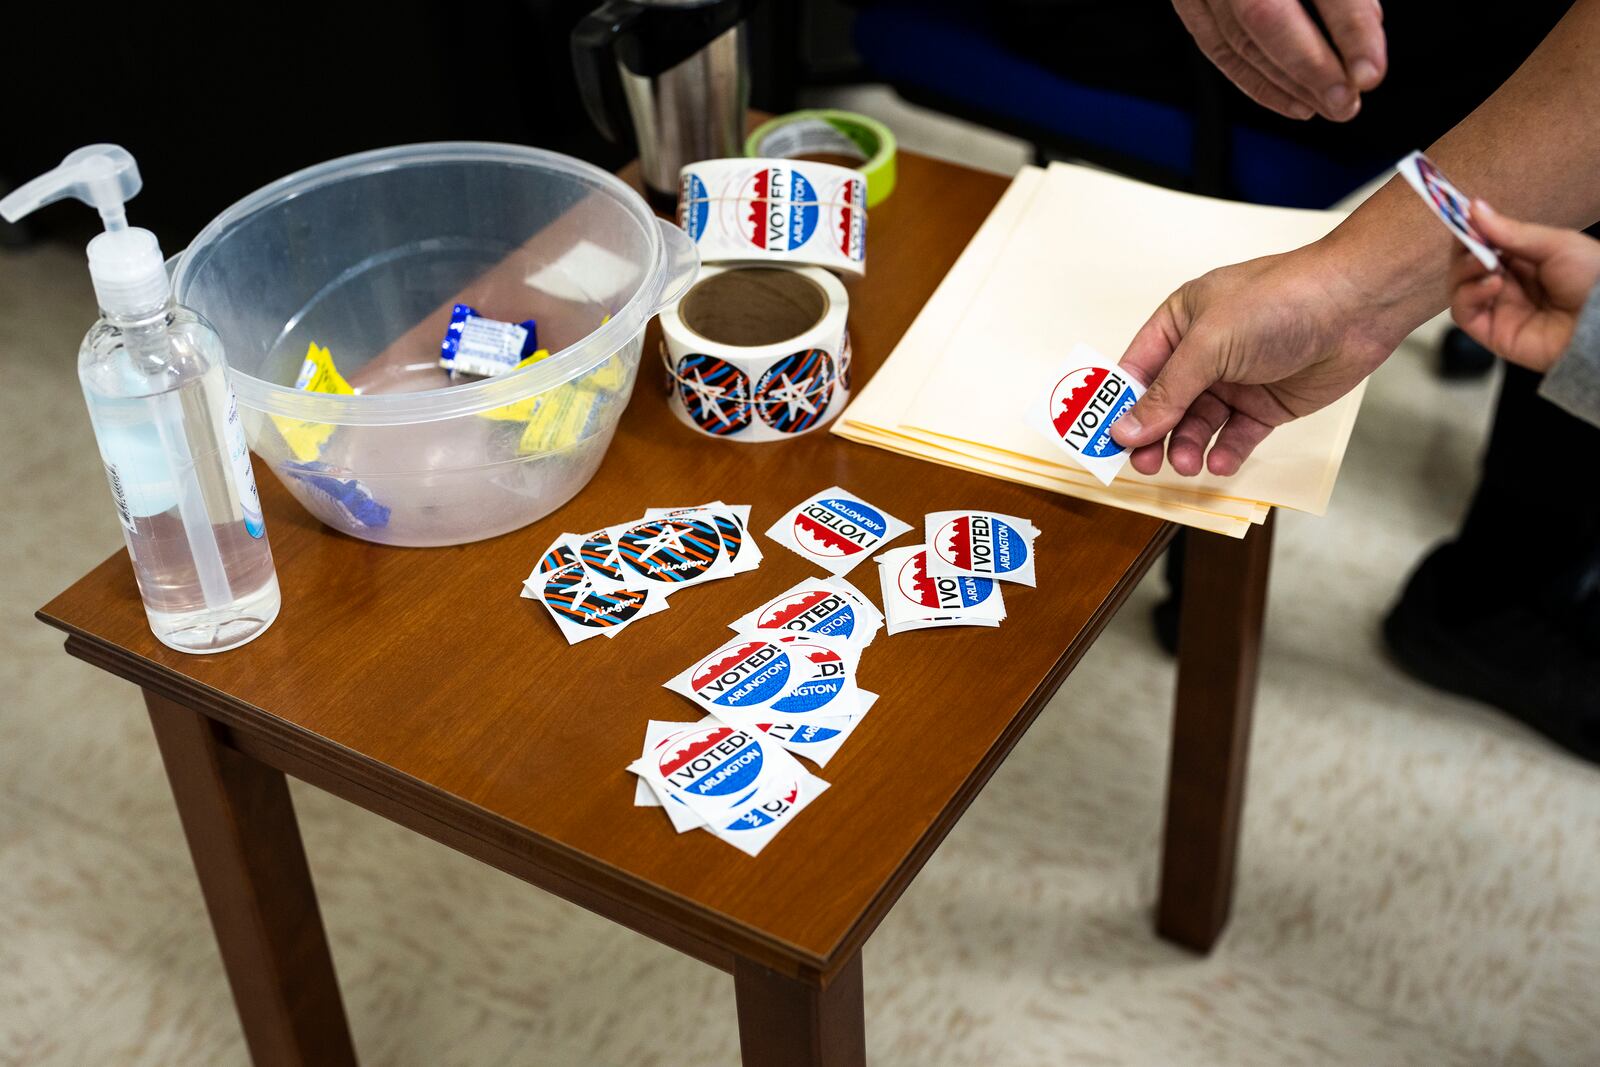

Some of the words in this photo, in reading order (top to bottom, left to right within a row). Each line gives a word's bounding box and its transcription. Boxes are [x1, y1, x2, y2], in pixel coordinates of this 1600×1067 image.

[1070, 373, 1126, 438] VOTED!
[1065, 438, 1080, 451] I
[802, 504, 867, 544] VOTED!
[828, 499, 884, 531] ARLINGTON
[865, 539, 878, 548] I
[971, 515, 991, 565] VOTED!
[998, 524, 1011, 570] ARLINGTON
[647, 559, 709, 575] Arlington
[964, 577, 979, 602] ARLIN
[583, 597, 641, 623] Arlington
[781, 594, 846, 631] OTED!
[697, 691, 711, 701] I
[706, 643, 782, 692] VOTED!
[727, 660, 788, 705] ARLINGTON
[668, 778, 681, 788] I
[676, 731, 753, 779] VOTED!
[697, 748, 761, 794] ARLINGTON
